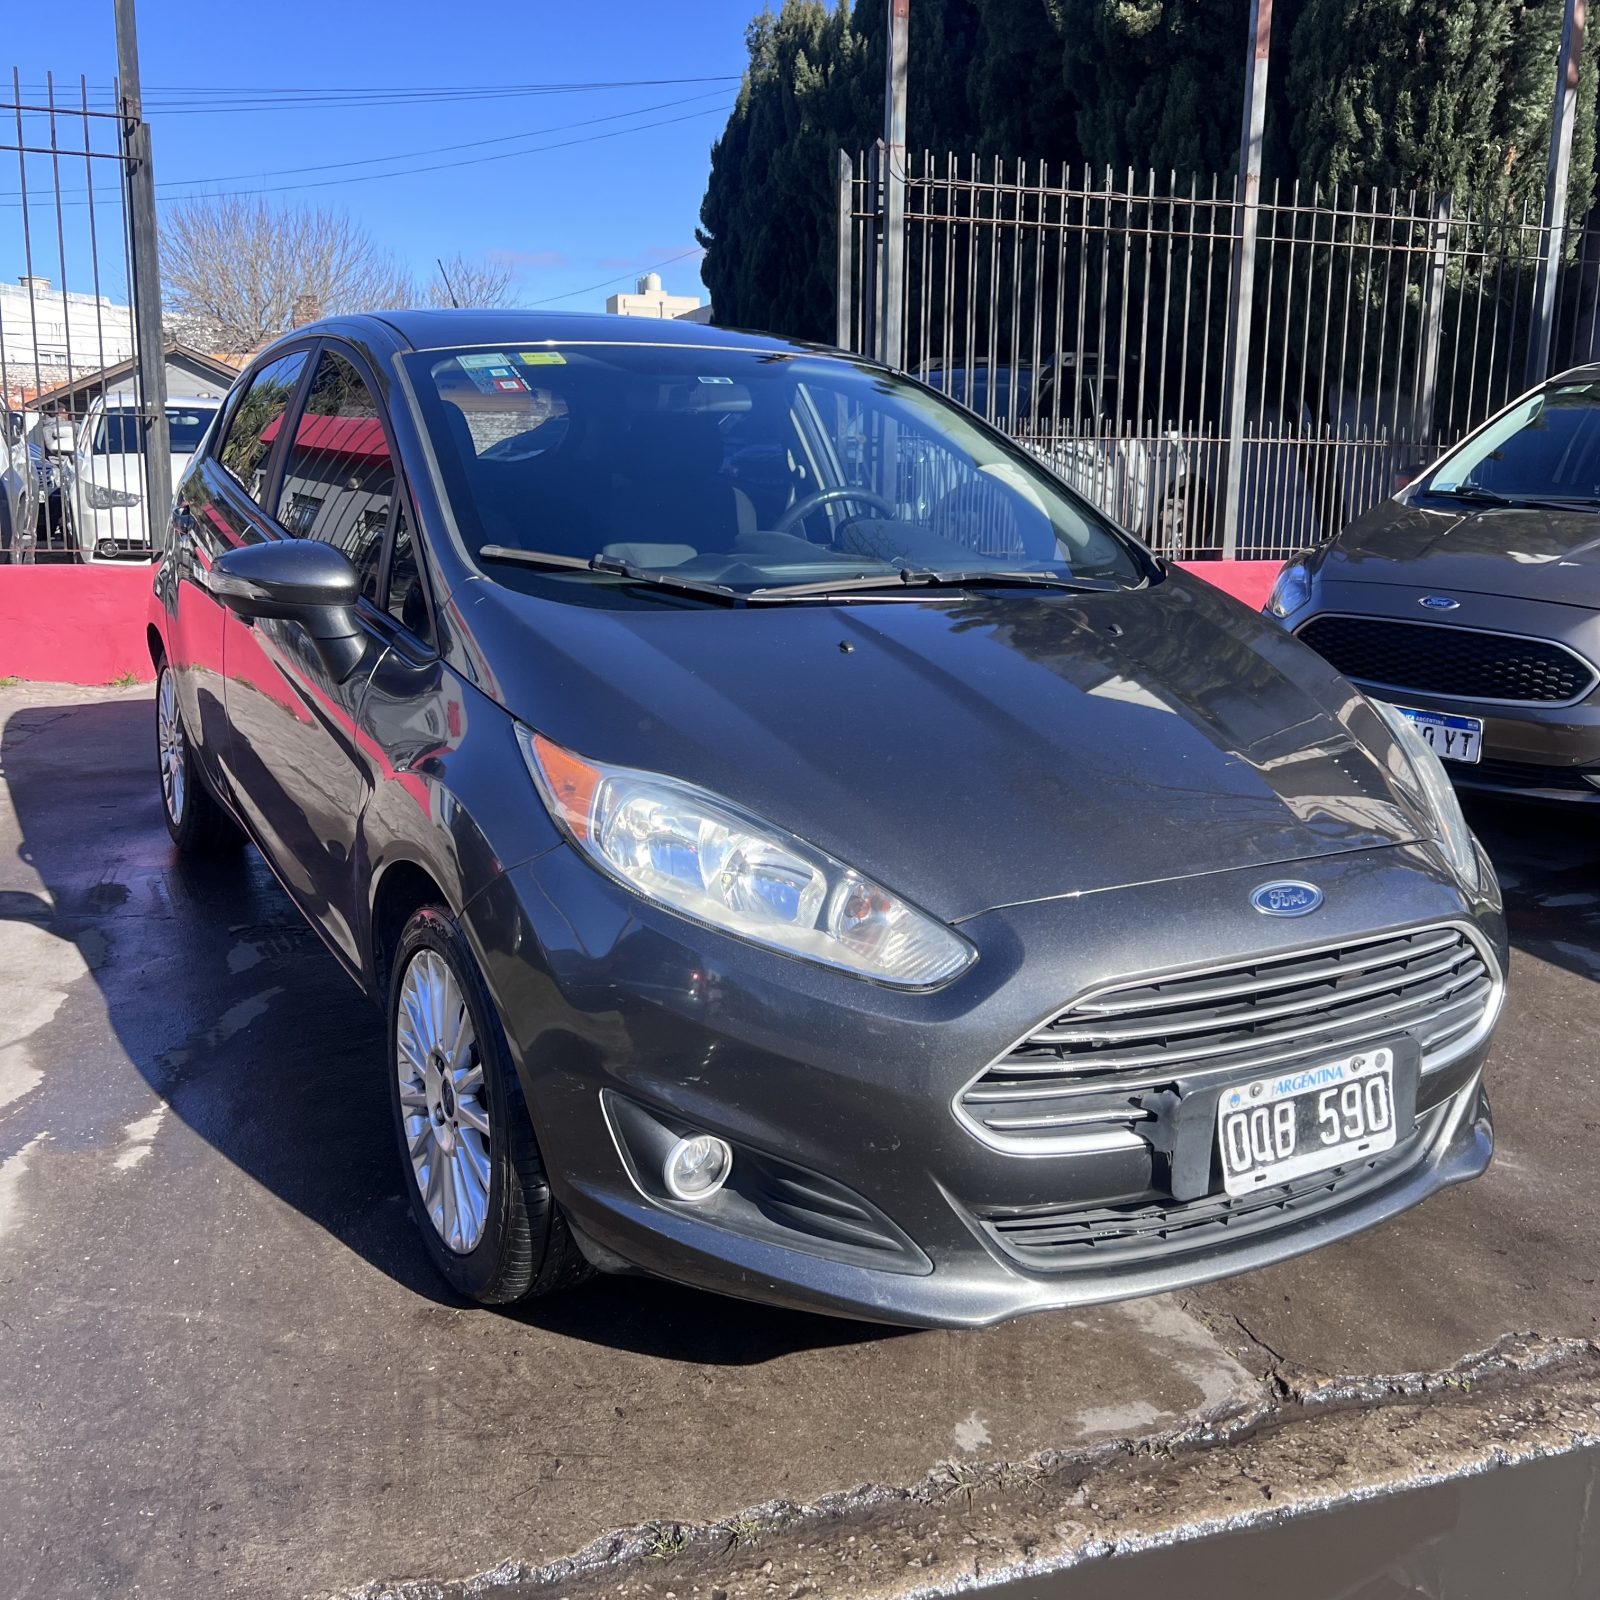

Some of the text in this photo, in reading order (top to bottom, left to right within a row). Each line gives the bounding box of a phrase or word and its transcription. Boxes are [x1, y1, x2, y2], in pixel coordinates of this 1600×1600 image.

[1445, 729, 1474, 757] YT
[1269, 888, 1307, 909] Ford
[1275, 1065, 1344, 1095] ARGENTINA
[1227, 1076, 1388, 1172] OQB 590
